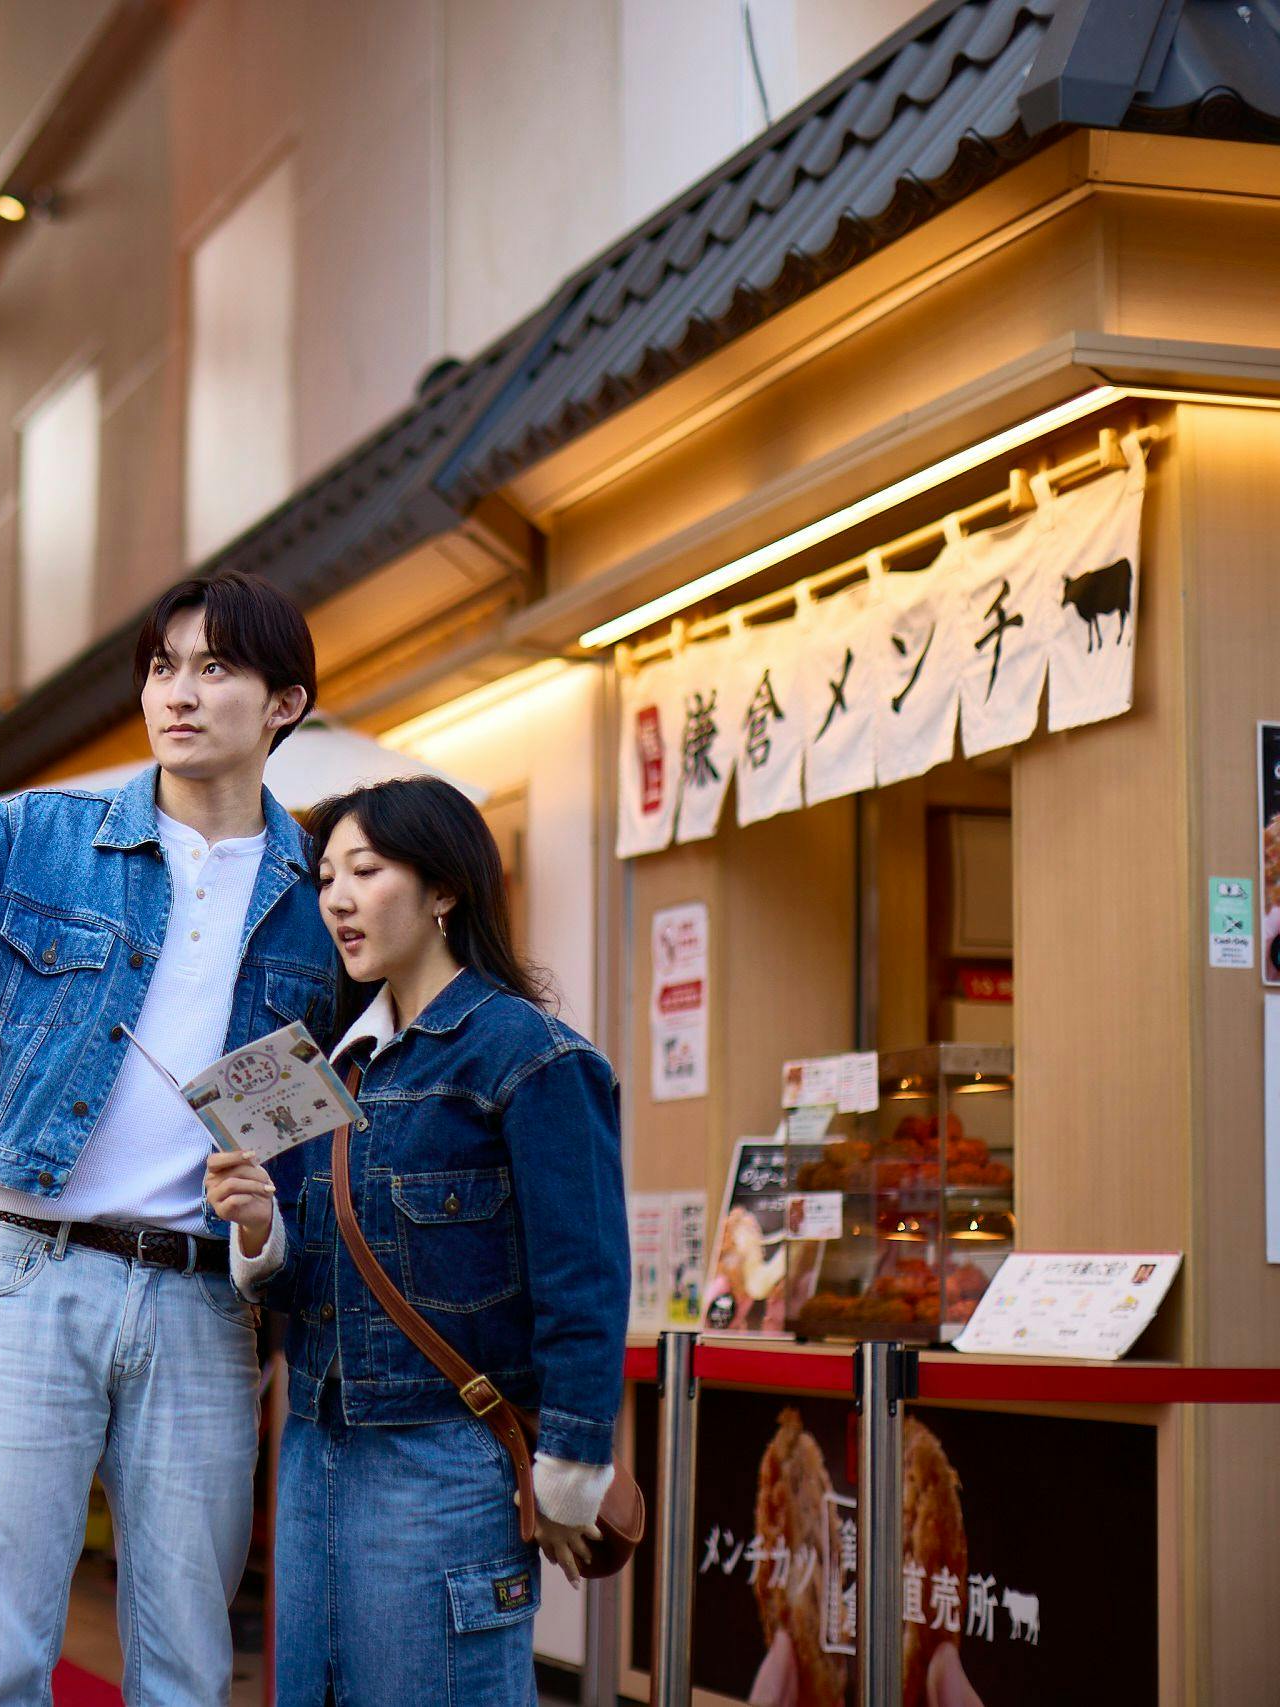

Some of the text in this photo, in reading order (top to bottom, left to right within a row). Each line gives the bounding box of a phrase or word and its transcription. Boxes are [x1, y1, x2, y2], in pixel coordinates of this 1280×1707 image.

[682, 577, 1024, 788] 鎌倉メンチ
[699, 1522, 818, 1600] メンチカツ
[903, 1559, 998, 1642] 直売所
